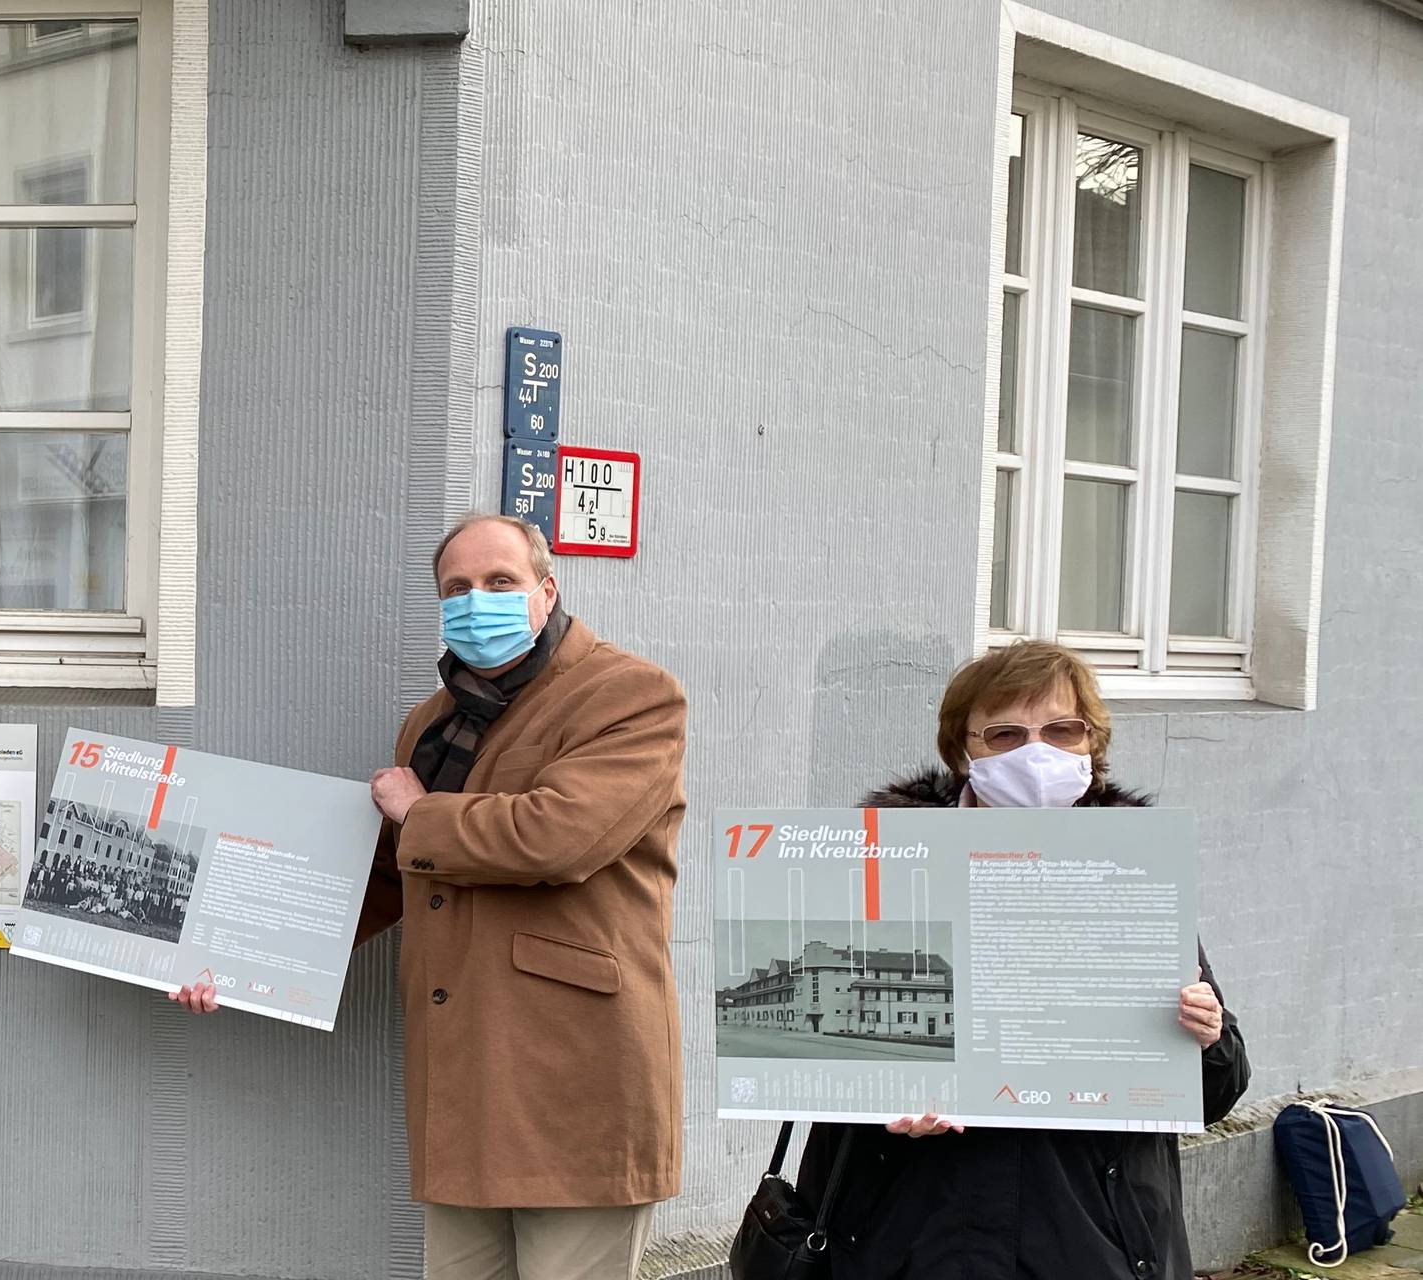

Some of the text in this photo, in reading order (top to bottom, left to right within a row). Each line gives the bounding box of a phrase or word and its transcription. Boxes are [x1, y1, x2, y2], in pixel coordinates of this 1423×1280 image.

[524, 352, 559, 379] S 200
[521, 463, 555, 489] S 200
[68, 741, 104, 768] 15
[104, 746, 165, 770] Siedlung
[101, 760, 186, 786] Mittelstraße
[725, 824, 774, 858] 17
[777, 825, 868, 845] Siedlung
[778, 842, 929, 859] Im Kreuzbruch
[213, 974, 236, 988] GBO
[253, 982, 271, 994] LEV
[1018, 1090, 1051, 1105] GBO
[1076, 1093, 1102, 1102] LEV
